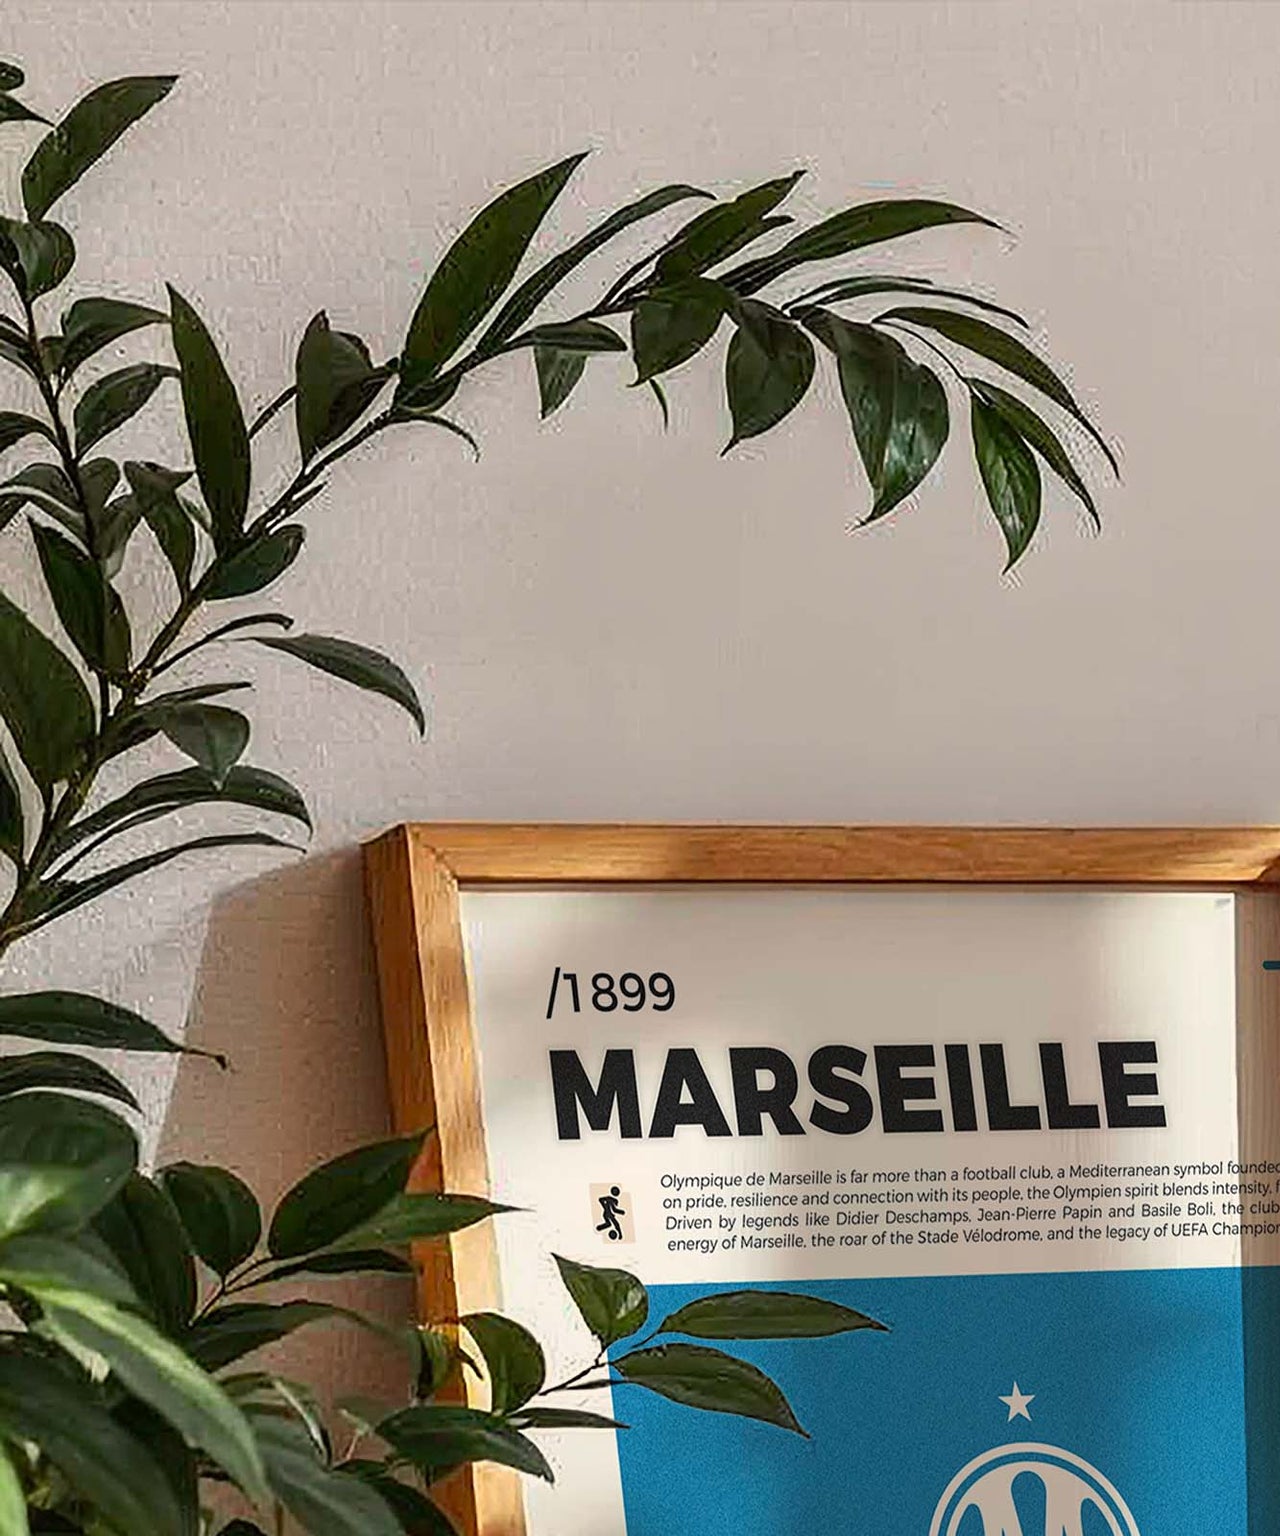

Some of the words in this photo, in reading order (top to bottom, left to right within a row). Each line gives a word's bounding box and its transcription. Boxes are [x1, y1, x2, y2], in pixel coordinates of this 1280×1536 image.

[546, 967, 675, 1019] /1899
[550, 1042, 1166, 1139] MARSEILLE
[660, 1172, 743, 1192] Olympique
[745, 1172, 765, 1186] de
[769, 1170, 832, 1185] Marseille
[836, 1169, 847, 1184] is
[850, 1169, 869, 1184] far
[872, 1171, 910, 1183] more
[914, 1168, 947, 1182] than
[950, 1170, 959, 1181] a
[963, 1165, 1016, 1181] football
[1056, 1167, 1065, 1179] a
[1069, 1163, 1170, 1178] Mediterranean
[1173, 1161, 1223, 1179] symbol
